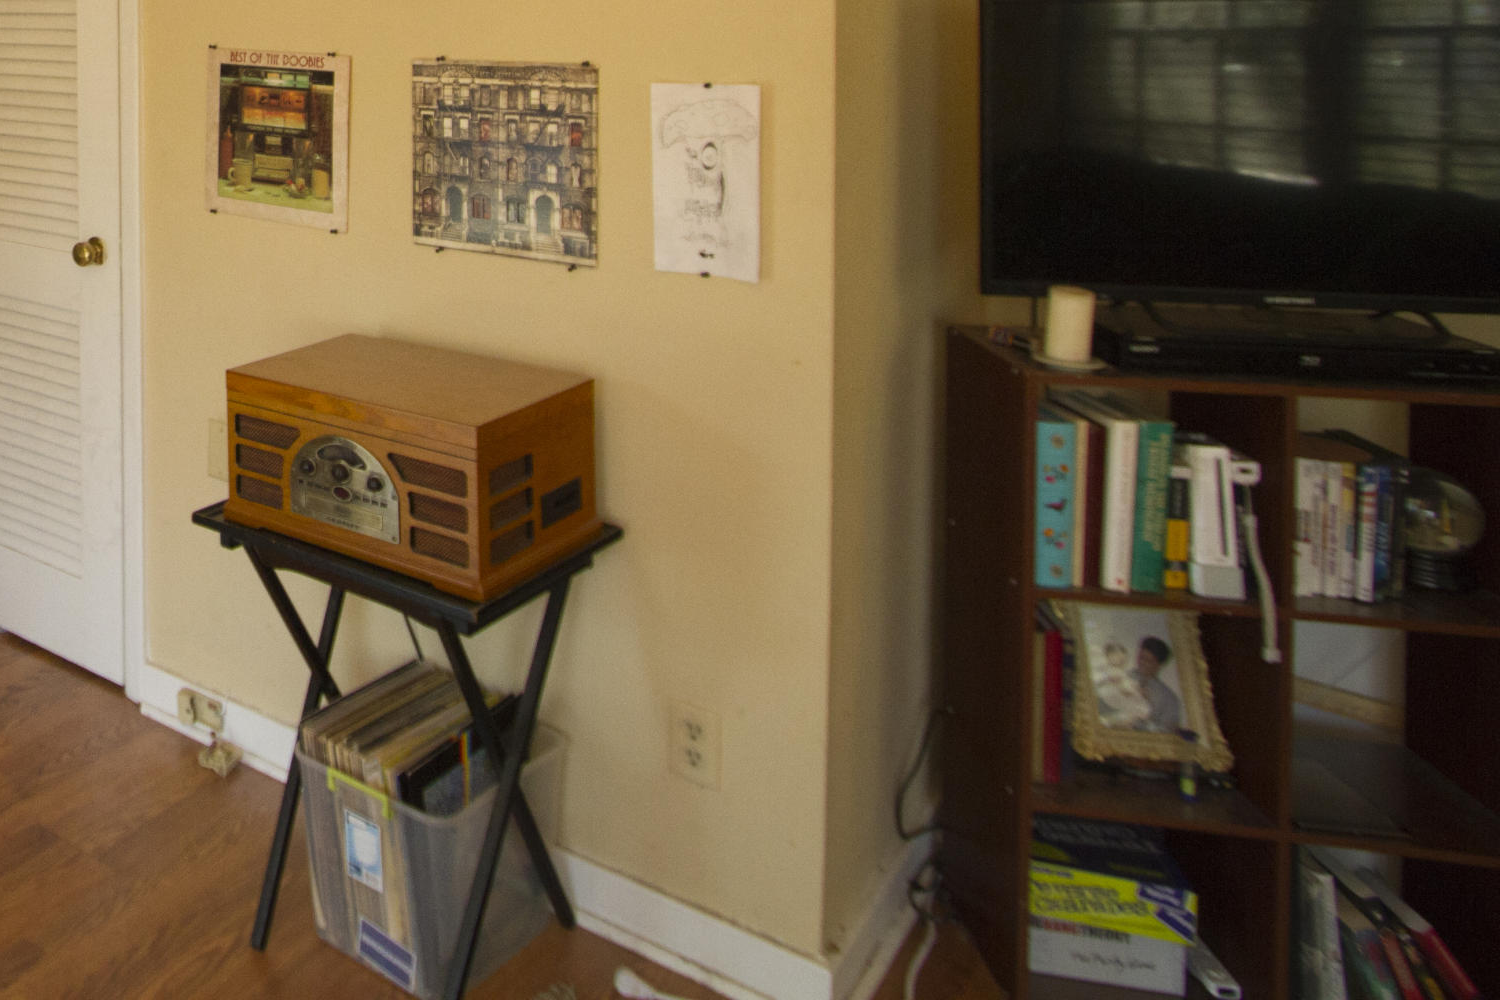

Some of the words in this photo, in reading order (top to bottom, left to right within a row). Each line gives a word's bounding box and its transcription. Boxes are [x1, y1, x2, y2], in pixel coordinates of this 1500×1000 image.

[229, 51, 248, 64] BEST
[249, 52, 263, 65] OF
[266, 53, 281, 66] THE
[282, 54, 326, 69] DOOBIES
